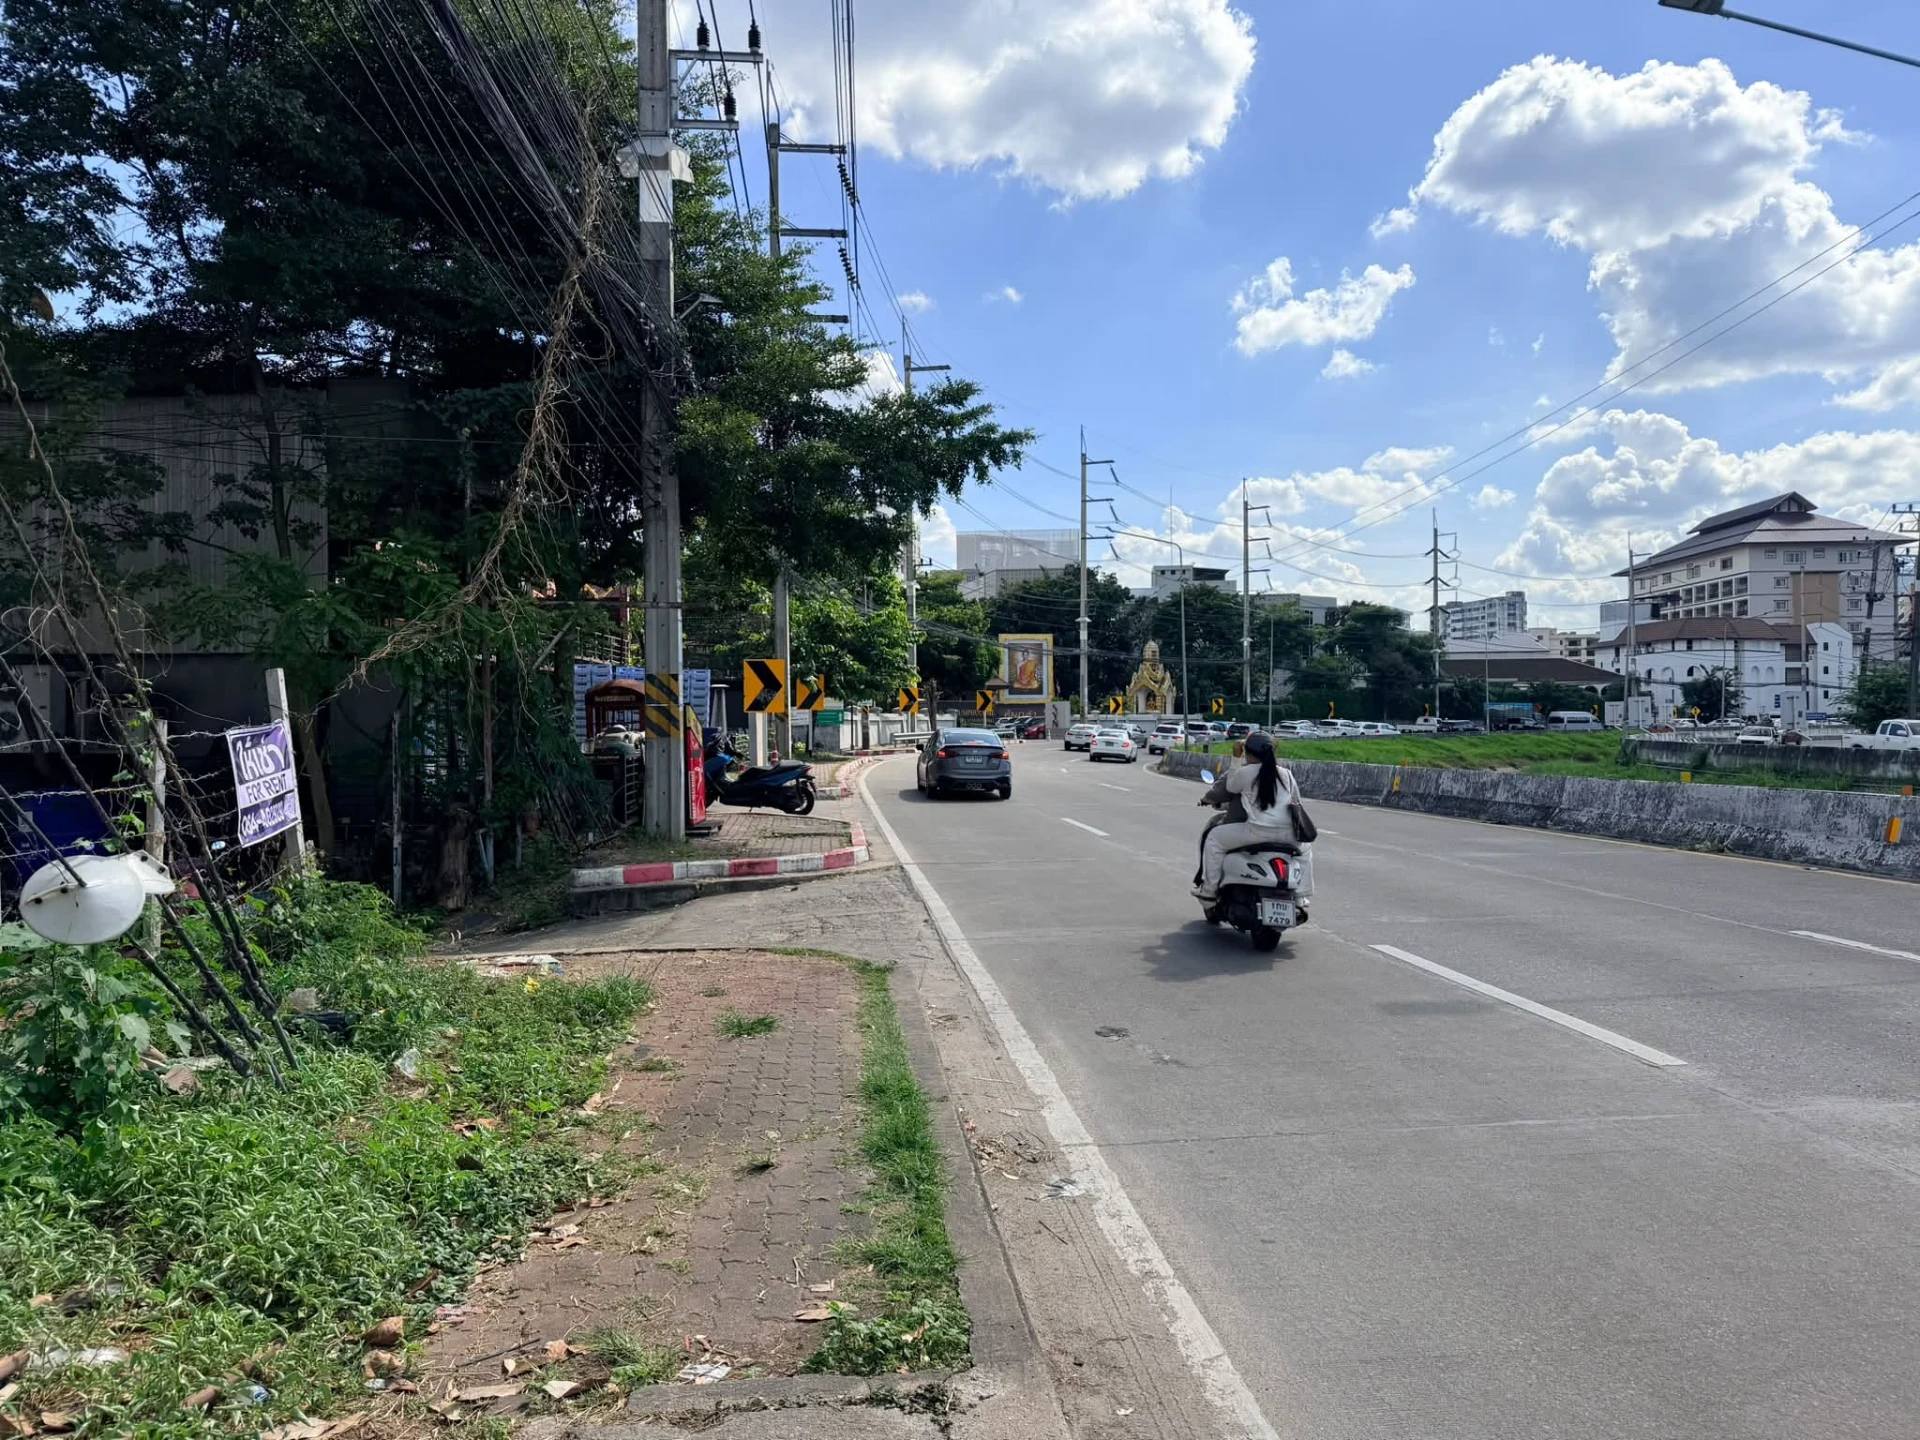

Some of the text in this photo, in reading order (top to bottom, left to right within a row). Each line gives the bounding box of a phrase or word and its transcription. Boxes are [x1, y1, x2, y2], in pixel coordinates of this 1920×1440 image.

[236, 735, 285, 780] ให้เช่า
[246, 774, 287, 803] FOR RENT
